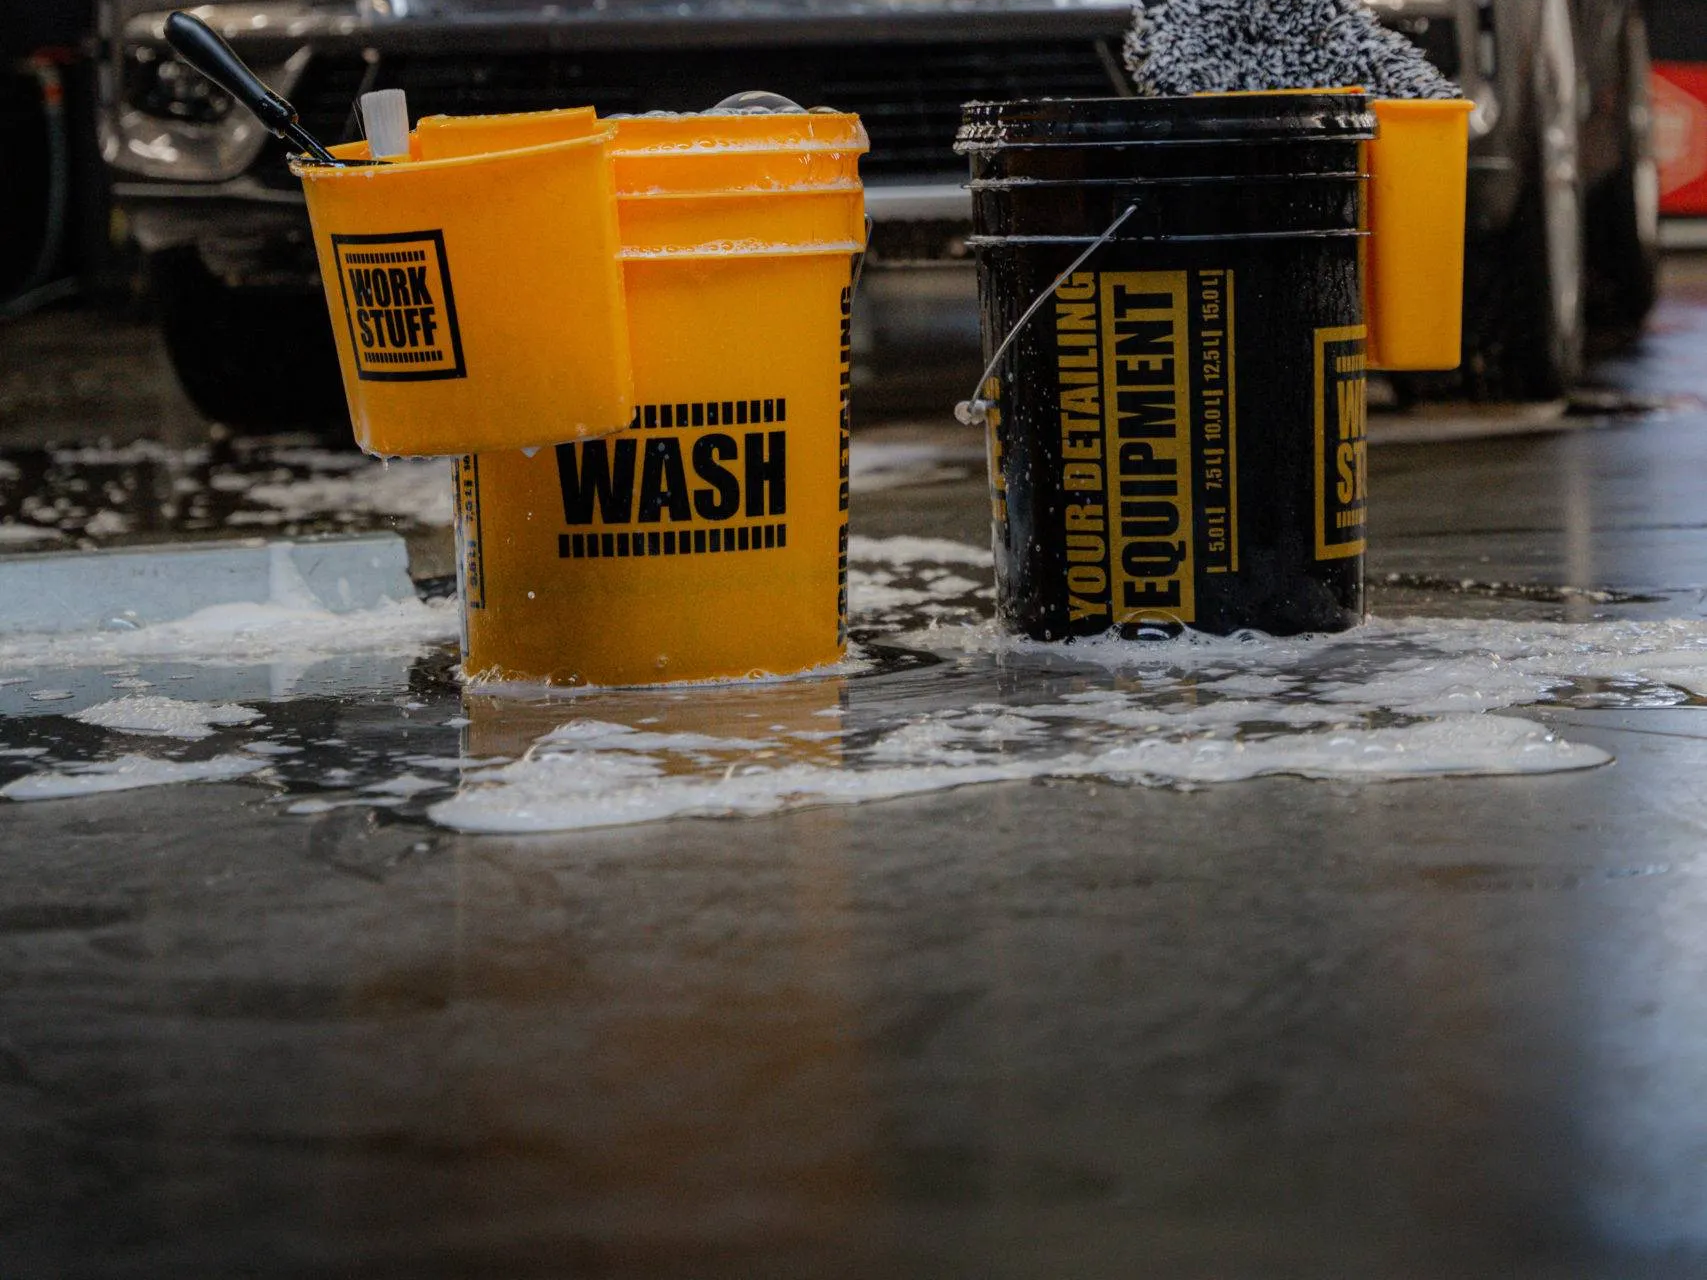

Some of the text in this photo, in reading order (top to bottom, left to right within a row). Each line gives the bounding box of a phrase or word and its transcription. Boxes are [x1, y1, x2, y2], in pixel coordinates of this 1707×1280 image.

[348, 266, 434, 308] WORK
[356, 306, 438, 349] STUFF
[555, 431, 786, 525] WASH
[1054, 272, 1107, 621] YOUR DETAILING
[1113, 284, 1187, 608] EQUIPMENT
